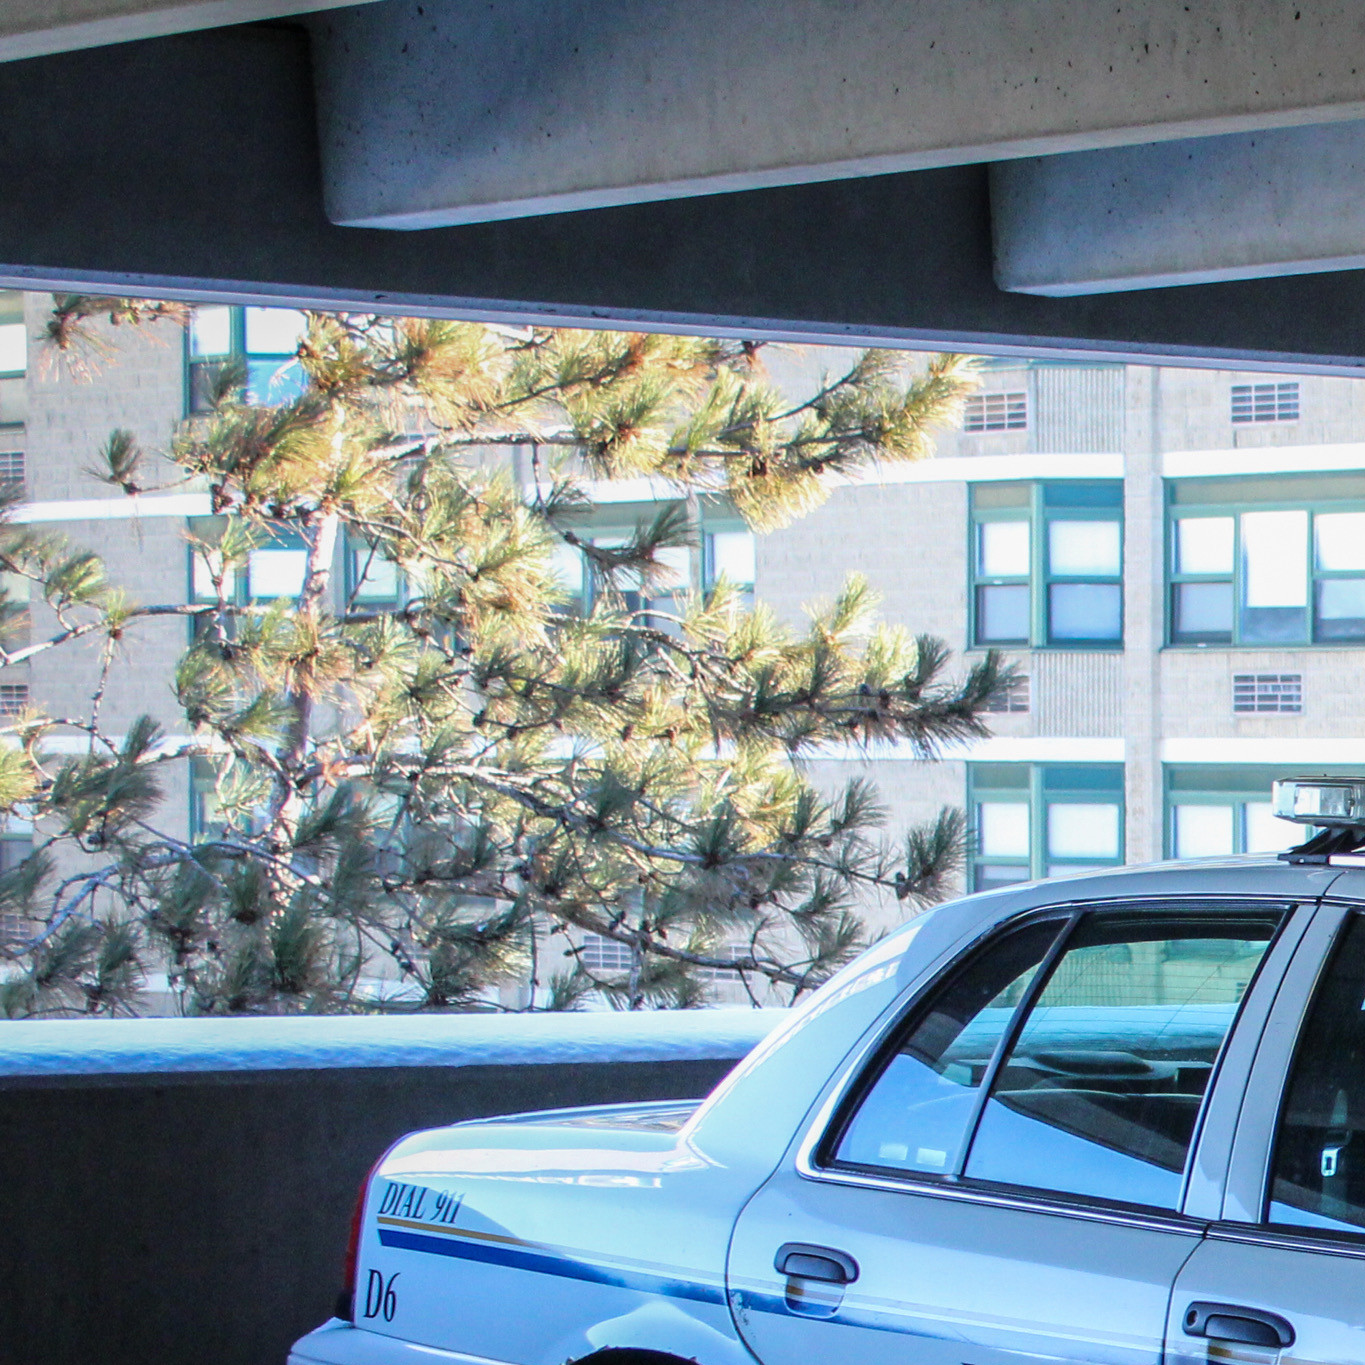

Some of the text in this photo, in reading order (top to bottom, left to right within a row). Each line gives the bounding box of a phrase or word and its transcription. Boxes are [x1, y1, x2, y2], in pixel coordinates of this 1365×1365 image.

[378, 1182, 466, 1224] DIAL 911
[364, 1269, 400, 1322] D6
